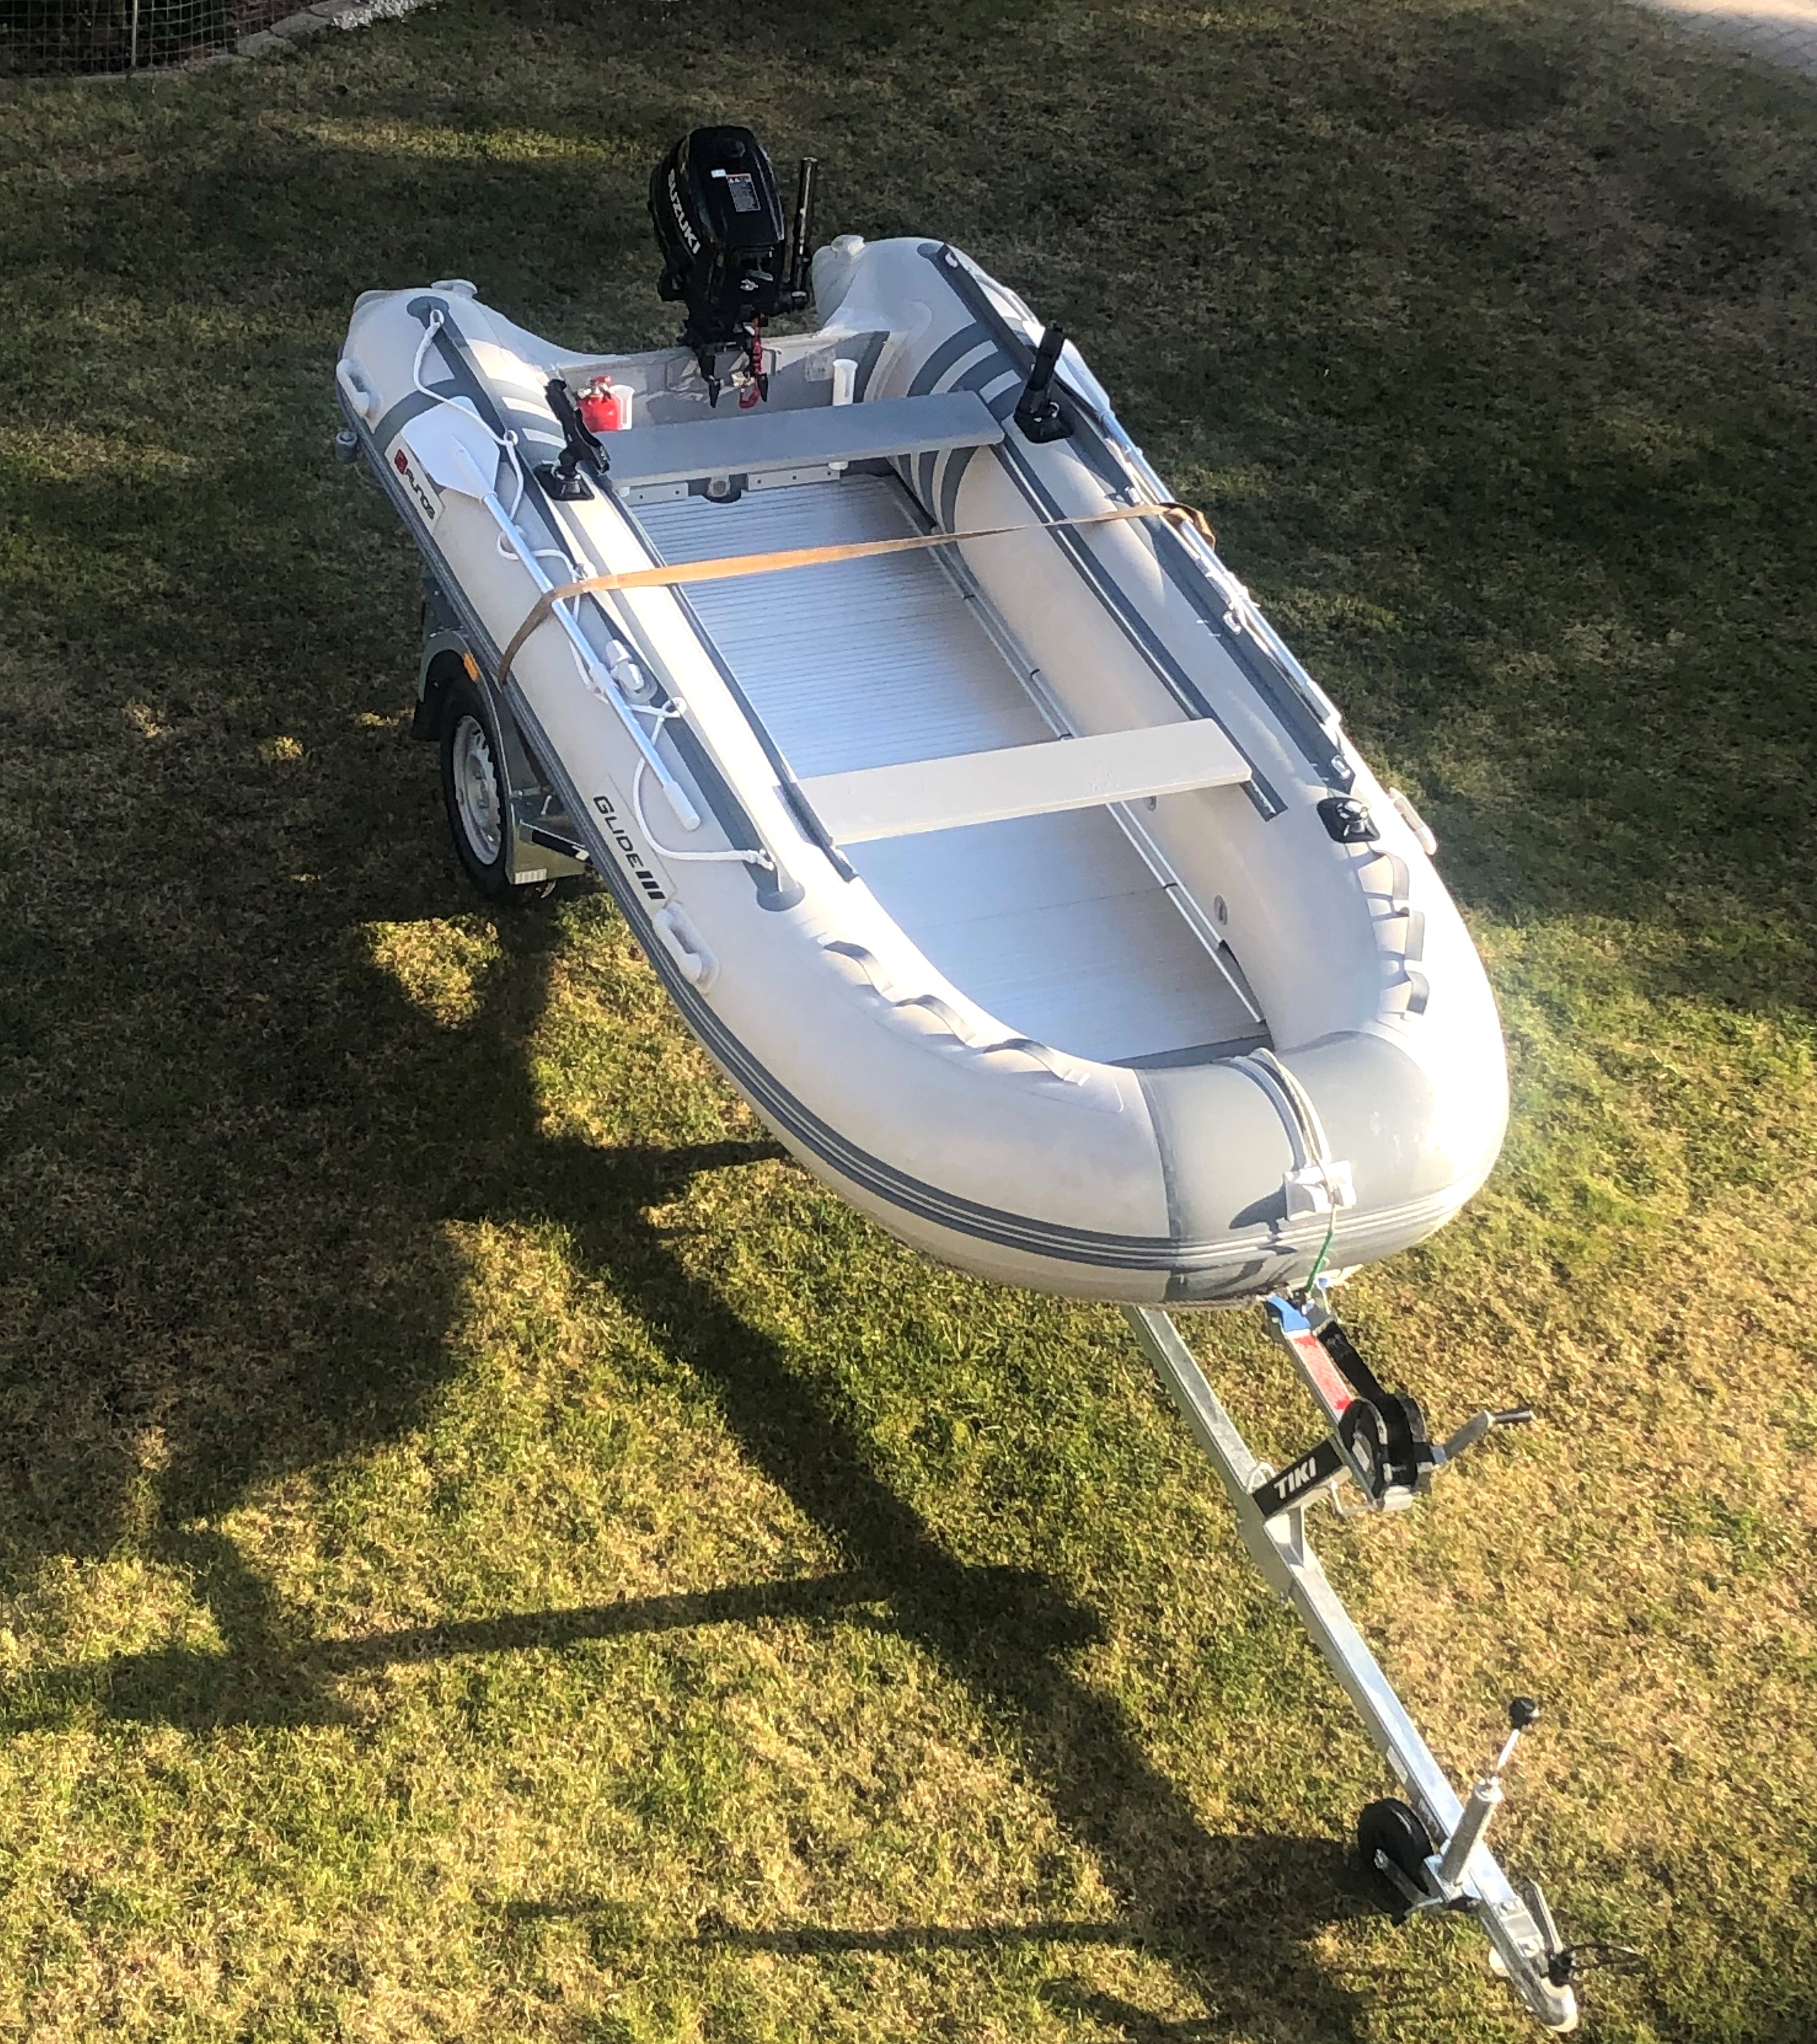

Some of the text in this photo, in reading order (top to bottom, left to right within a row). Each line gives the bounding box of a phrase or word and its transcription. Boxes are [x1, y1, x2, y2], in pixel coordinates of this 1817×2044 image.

[668, 168, 701, 254] SUZUKI
[593, 795, 644, 868] GLIDE
[1274, 1457, 1316, 1499] TIKI
